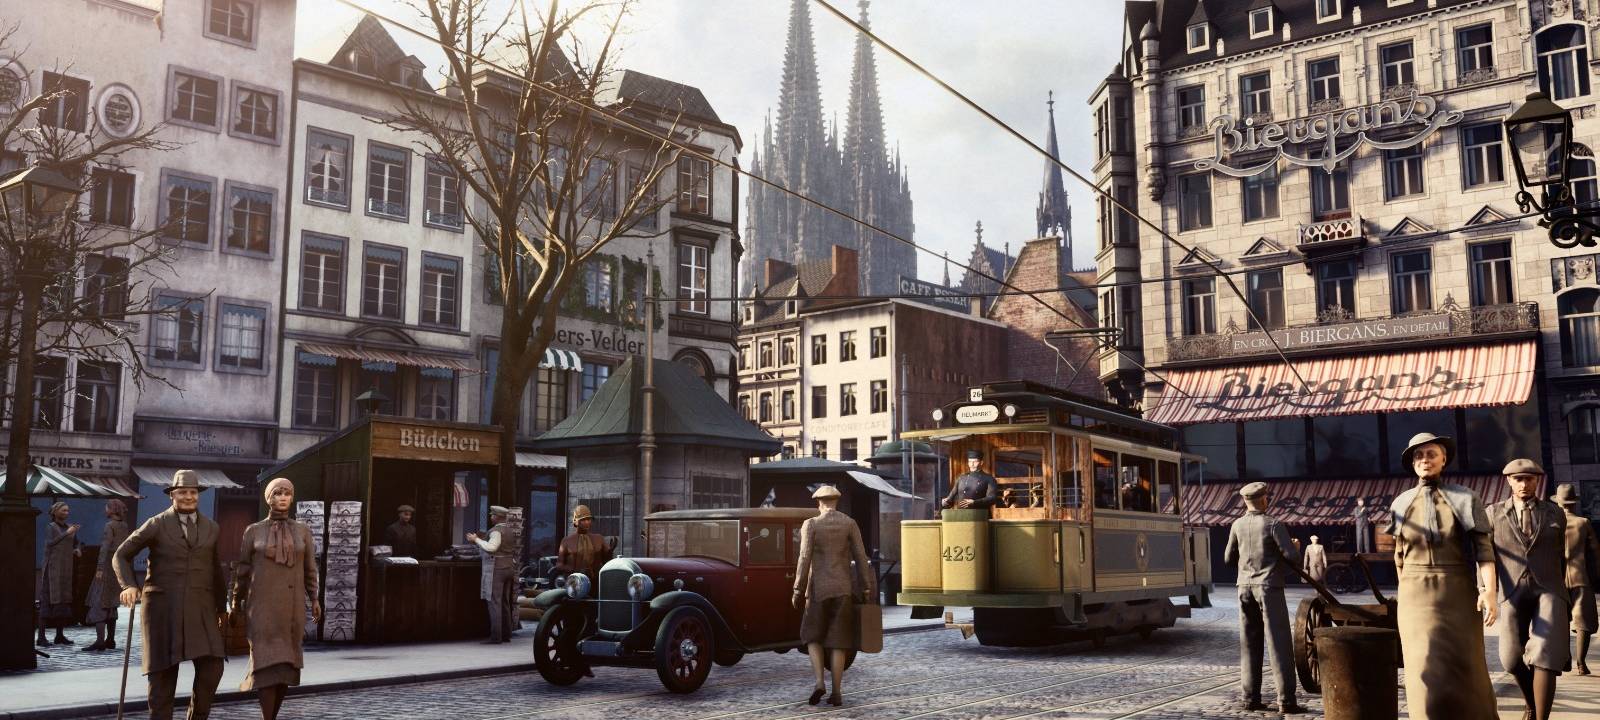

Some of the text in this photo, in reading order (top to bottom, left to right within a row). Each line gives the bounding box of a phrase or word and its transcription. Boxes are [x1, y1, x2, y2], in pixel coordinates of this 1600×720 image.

[1195, 90, 1464, 176] Biergans
[1233, 340, 1248, 350] EN
[1393, 325, 1408, 335] EN
[1410, 320, 1449, 333] DETAIL
[400, 428, 480, 452] Büdchen
[941, 545, 976, 561] 429
